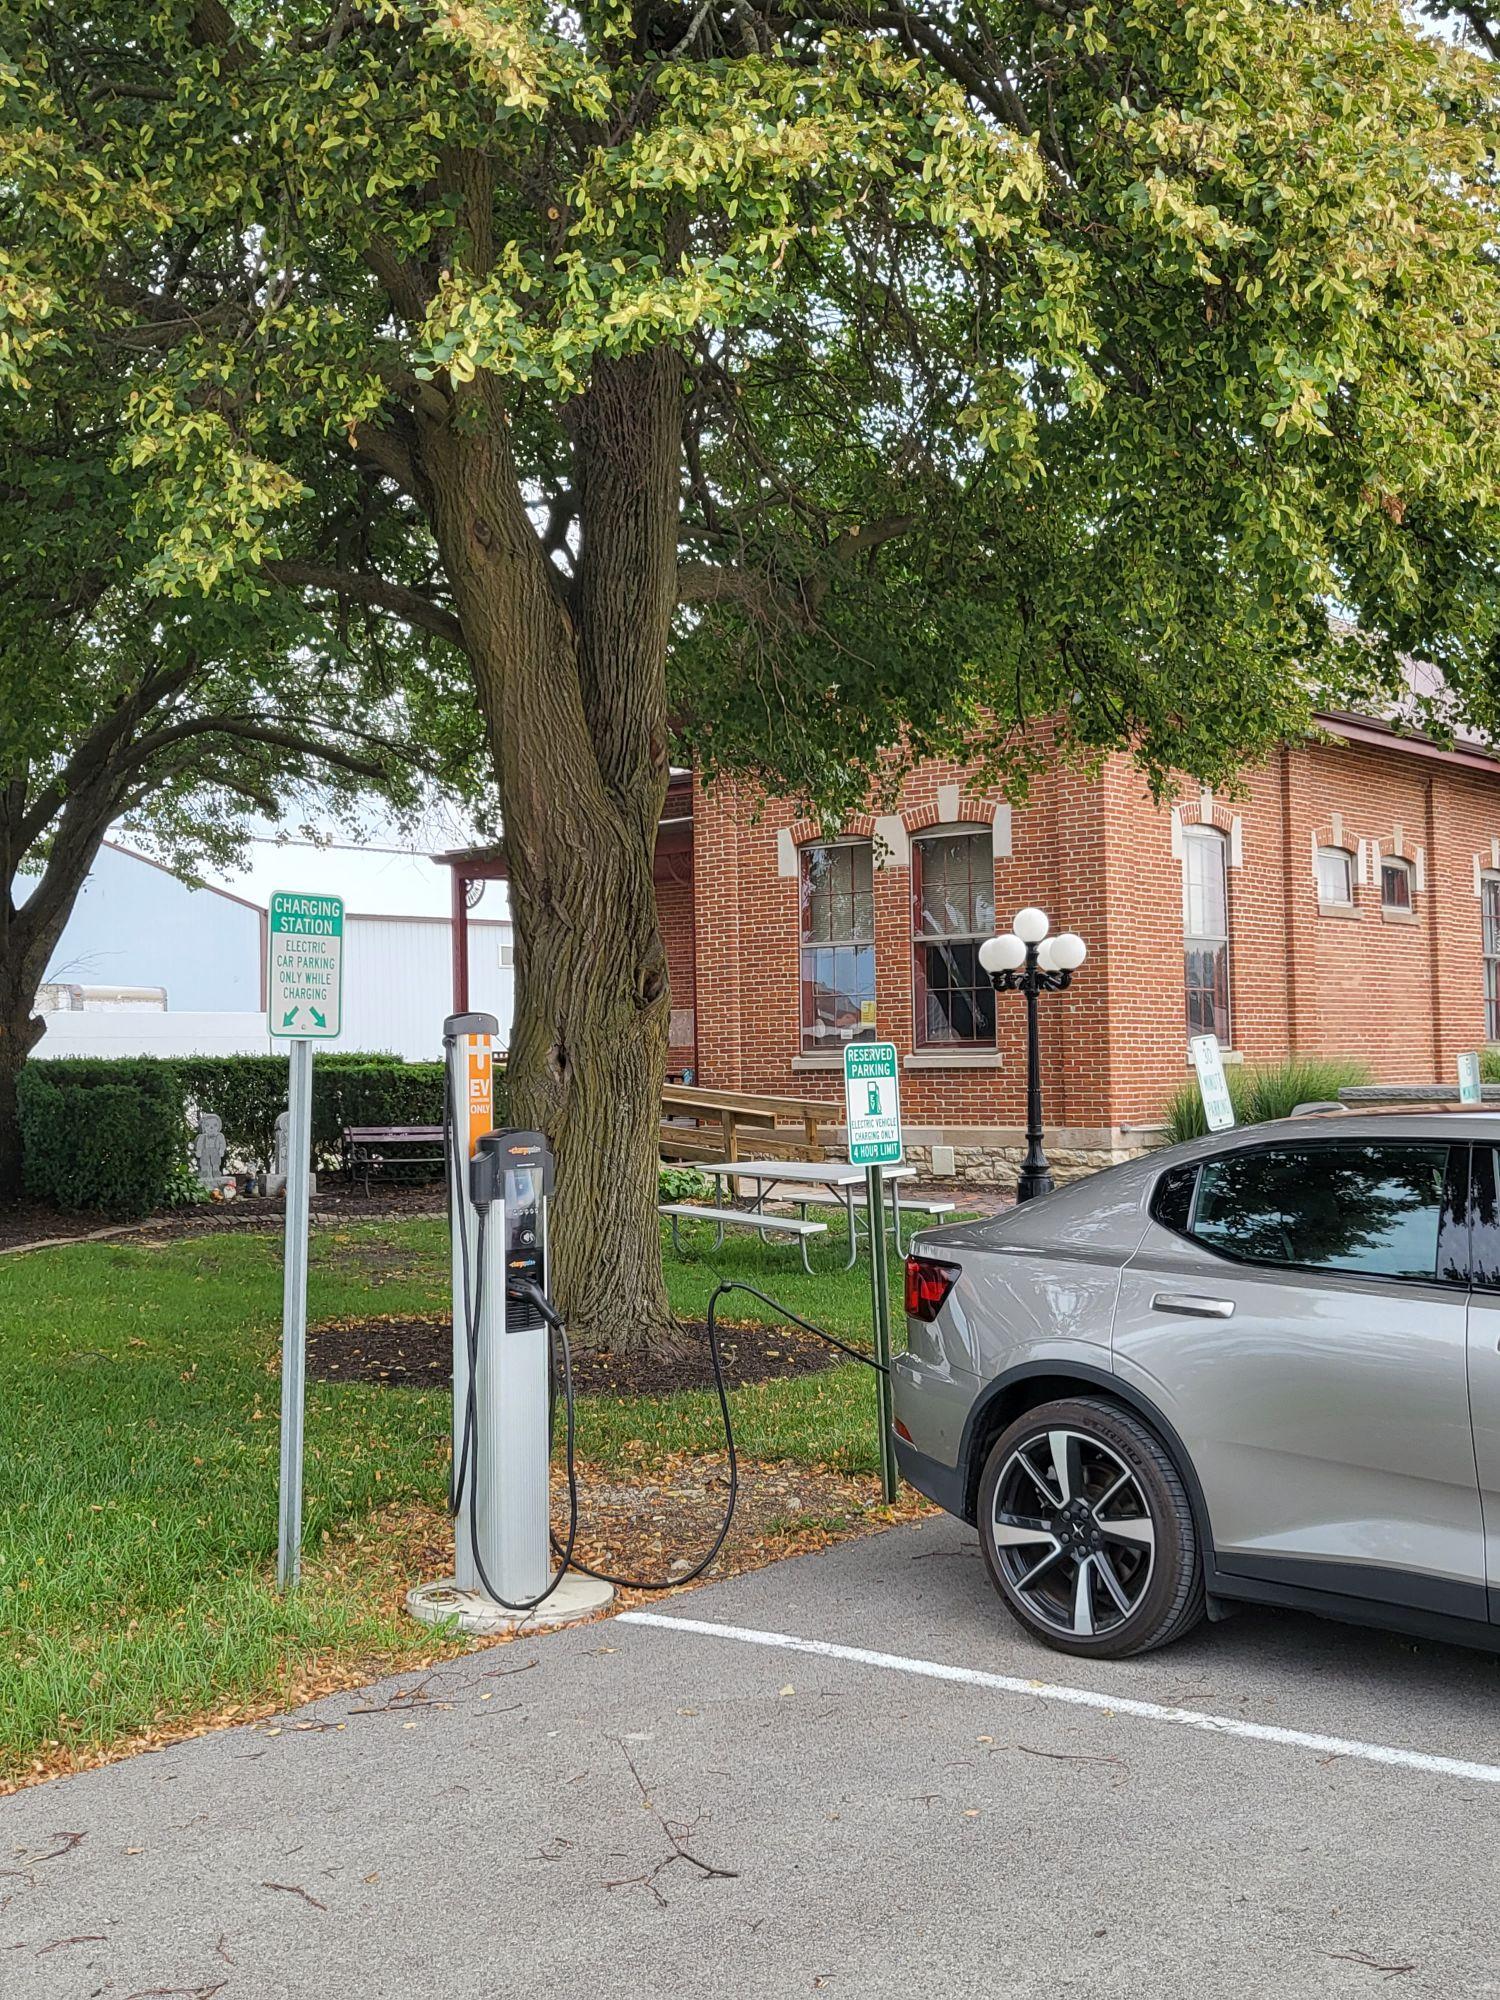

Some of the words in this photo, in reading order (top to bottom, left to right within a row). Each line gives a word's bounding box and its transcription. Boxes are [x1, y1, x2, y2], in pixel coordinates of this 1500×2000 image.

[275, 897, 340, 917] CHARGING
[280, 916, 333, 934] STATION
[286, 939, 326, 954] ELECTRIC
[277, 955, 294, 968] CAR
[297, 956, 335, 970] PARKING
[279, 971, 301, 984] ONLY
[305, 972, 332, 985] WHILE
[283, 986, 327, 1000] CHARGING
[848, 1047, 893, 1062] RESERVED
[851, 1062, 891, 1077] PARKING
[470, 1079, 490, 1097] EV
[470, 1104, 490, 1114] ONLY
[870, 1094, 875, 1110] EV
[851, 1118, 875, 1130] ELECTRIC
[875, 1117, 897, 1128] VEHICLE
[855, 1130, 880, 1142] CHARGING
[881, 1129, 894, 1140] ONLY
[853, 1146, 859, 1159] 4
[860, 1144, 879, 1158] HOUR
[880, 1142, 898, 1156] LIMIT
